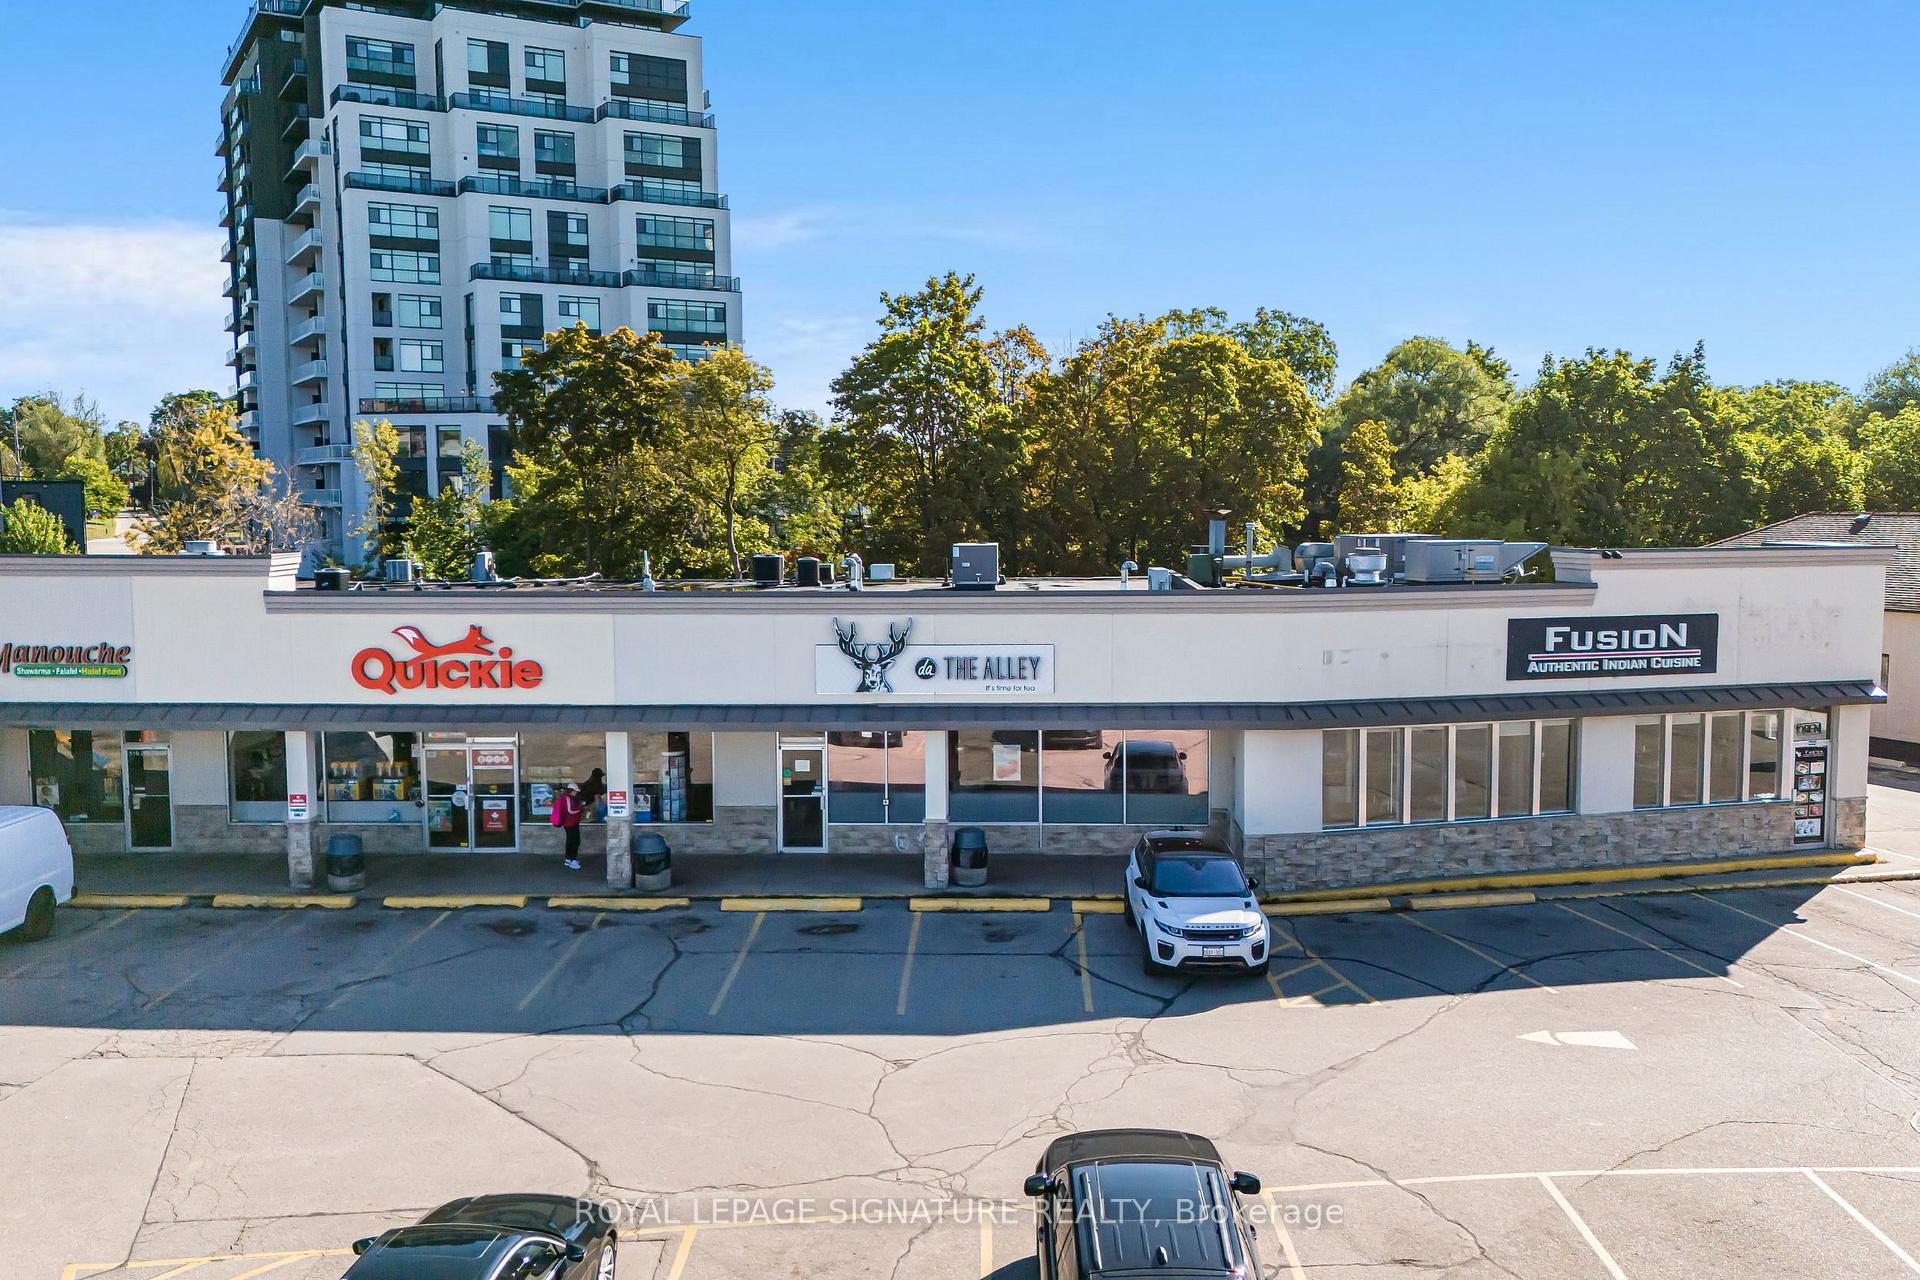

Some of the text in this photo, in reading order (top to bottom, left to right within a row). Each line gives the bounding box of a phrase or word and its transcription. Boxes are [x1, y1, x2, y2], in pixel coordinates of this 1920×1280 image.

[1545, 622, 1688, 652] FUSION
[943, 656, 978, 680] THE
[983, 656, 1041, 680] ALLEY
[1527, 656, 1701, 673] AUTHENTIC INDIAN CUISINE
